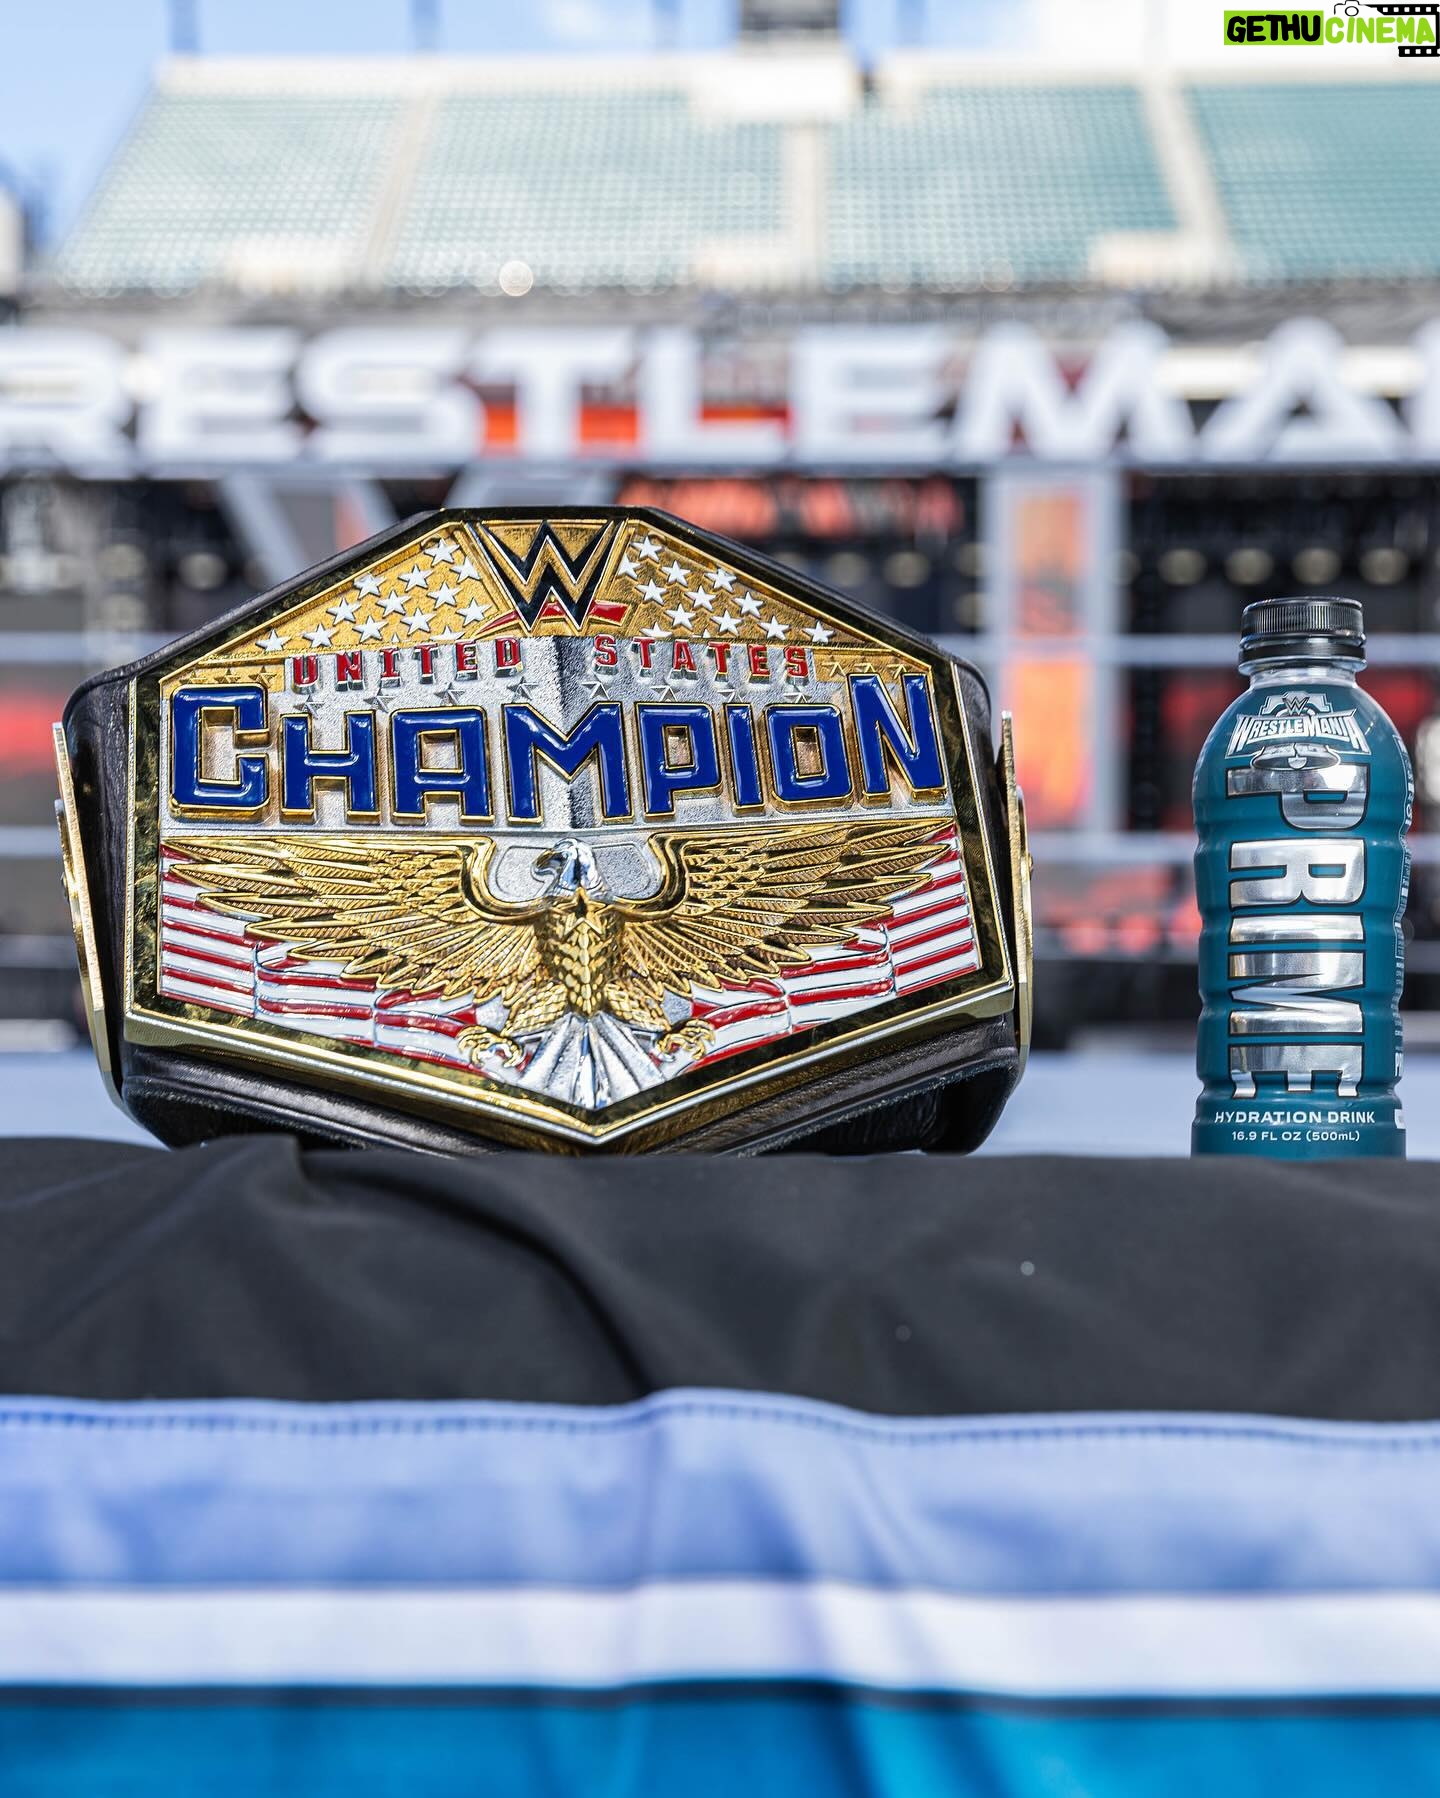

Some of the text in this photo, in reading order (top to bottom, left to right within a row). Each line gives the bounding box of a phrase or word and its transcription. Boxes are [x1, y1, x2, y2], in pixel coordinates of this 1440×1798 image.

[0, 320, 1440, 468] RESTLEMA
[292, 634, 809, 689] UNITED STATES
[170, 672, 948, 826] CHAMPION
[1226, 709, 1370, 757] WRESTLEMANIA
[1226, 764, 1369, 1097] PRIME
[1214, 1111, 1375, 1124] HYDRATION DRINK
[1232, 1130, 1360, 1142] 16.9 FL OZ (500mL)
